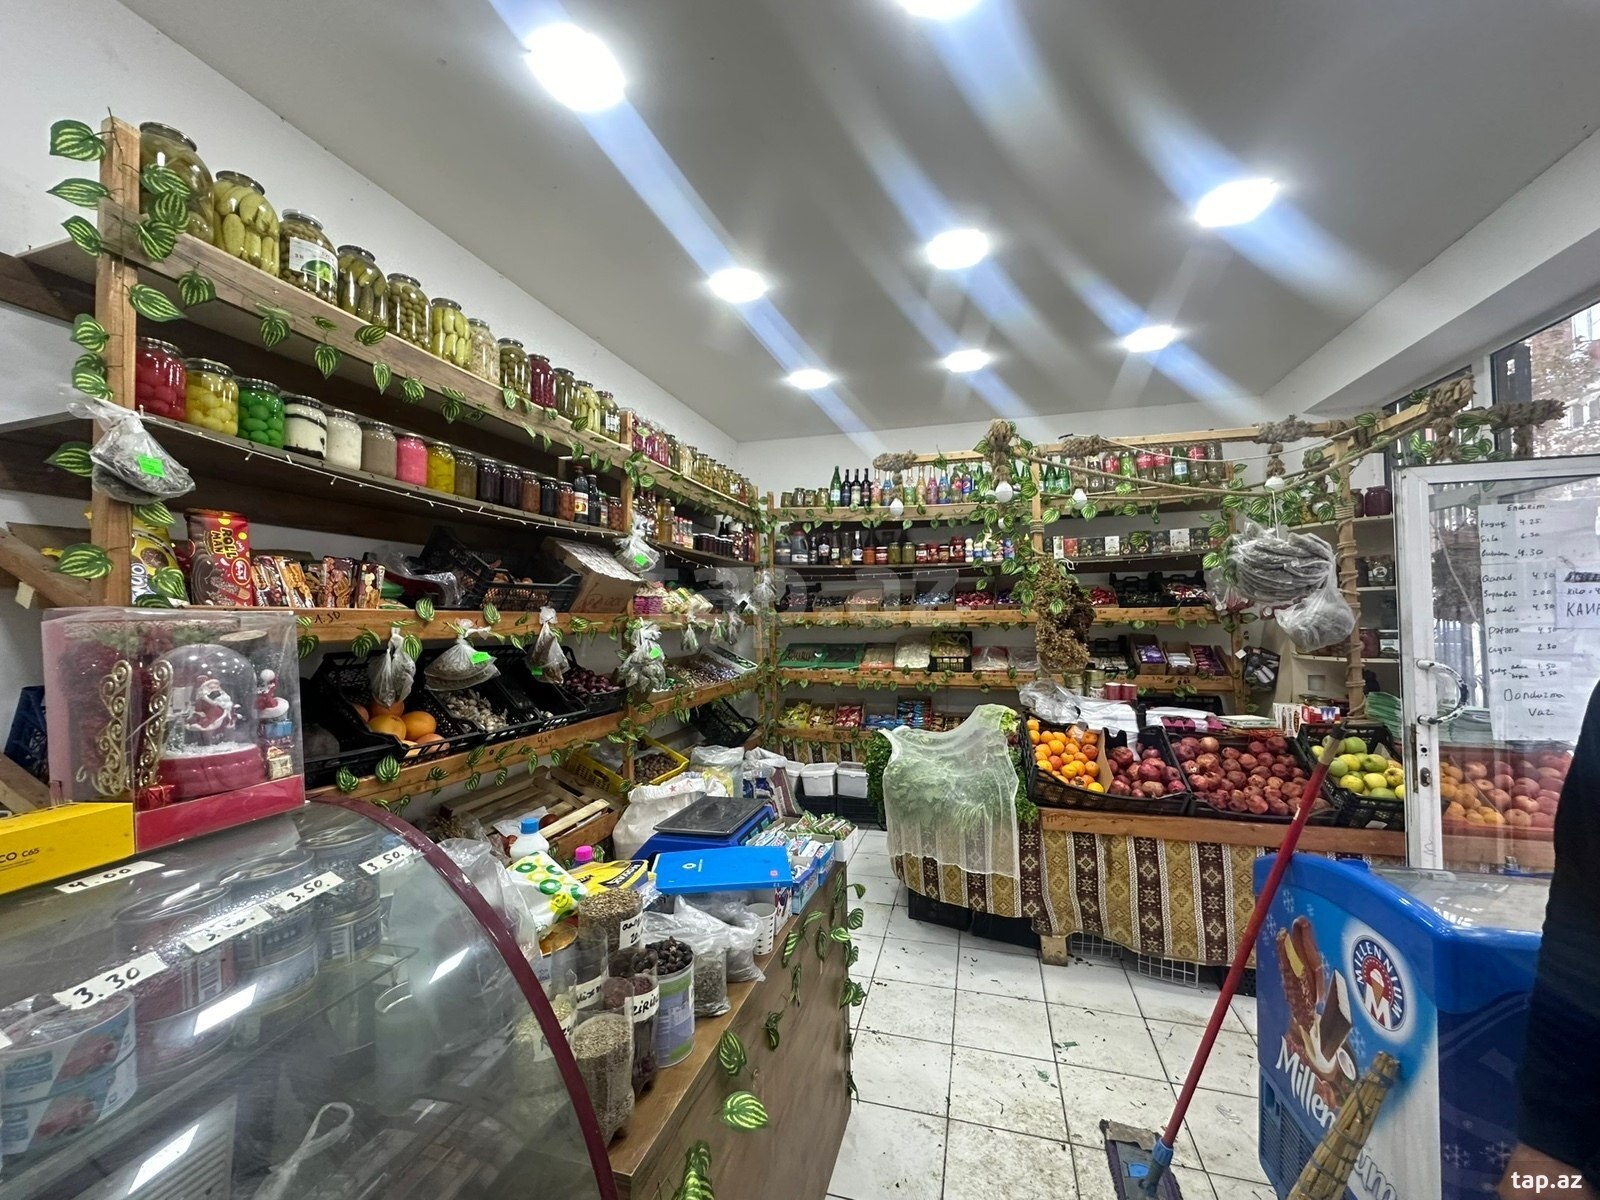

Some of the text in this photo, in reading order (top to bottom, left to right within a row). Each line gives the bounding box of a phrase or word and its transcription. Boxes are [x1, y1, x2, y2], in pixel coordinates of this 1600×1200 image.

[211, 530, 226, 554] MAN
[220, 526, 238, 559] ROLL
[21, 847, 40, 858] C65
[72, 967, 141, 1005] 3.30
[1354, 941, 1403, 1018] MILLENNIUM
